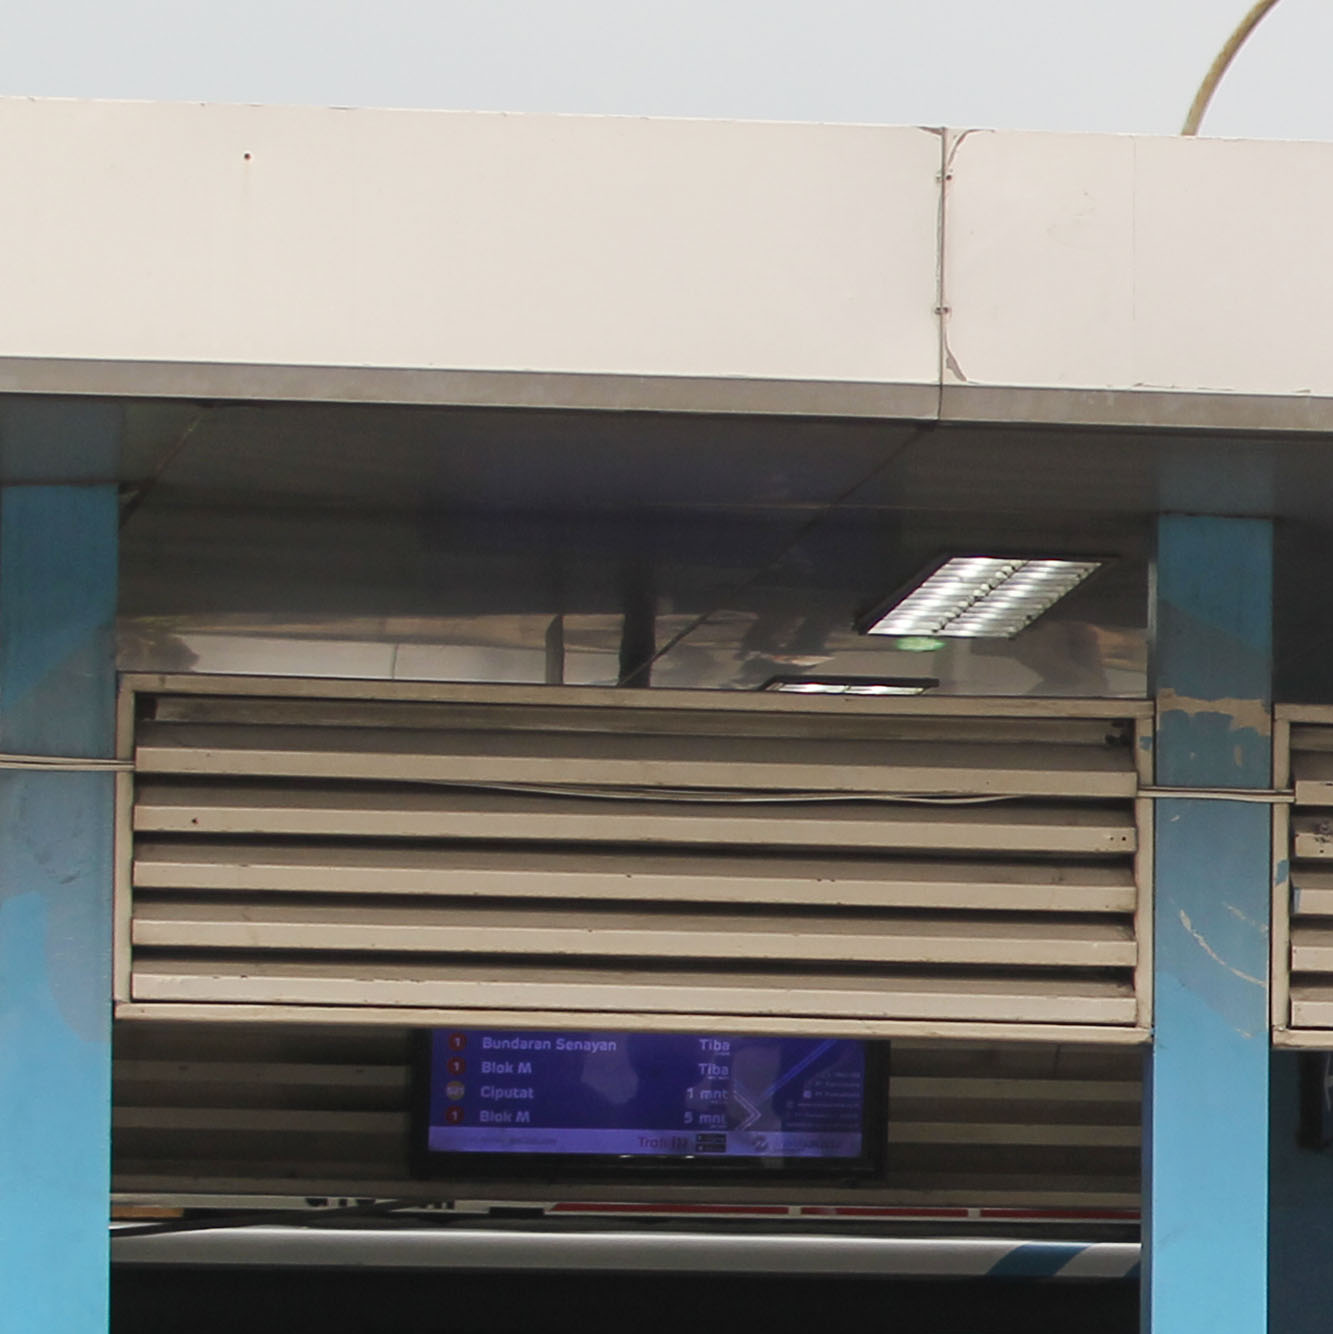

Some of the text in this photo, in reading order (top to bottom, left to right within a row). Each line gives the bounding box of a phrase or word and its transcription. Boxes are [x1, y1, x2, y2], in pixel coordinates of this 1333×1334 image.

[482, 1037, 617, 1053] Bundaran Senayan
[699, 1038, 731, 1051] Tiba
[481, 1061, 532, 1074] Blok M
[698, 1063, 729, 1076] Tiba
[480, 1086, 535, 1100] Ciputat
[479, 1110, 531, 1123] Blok M
